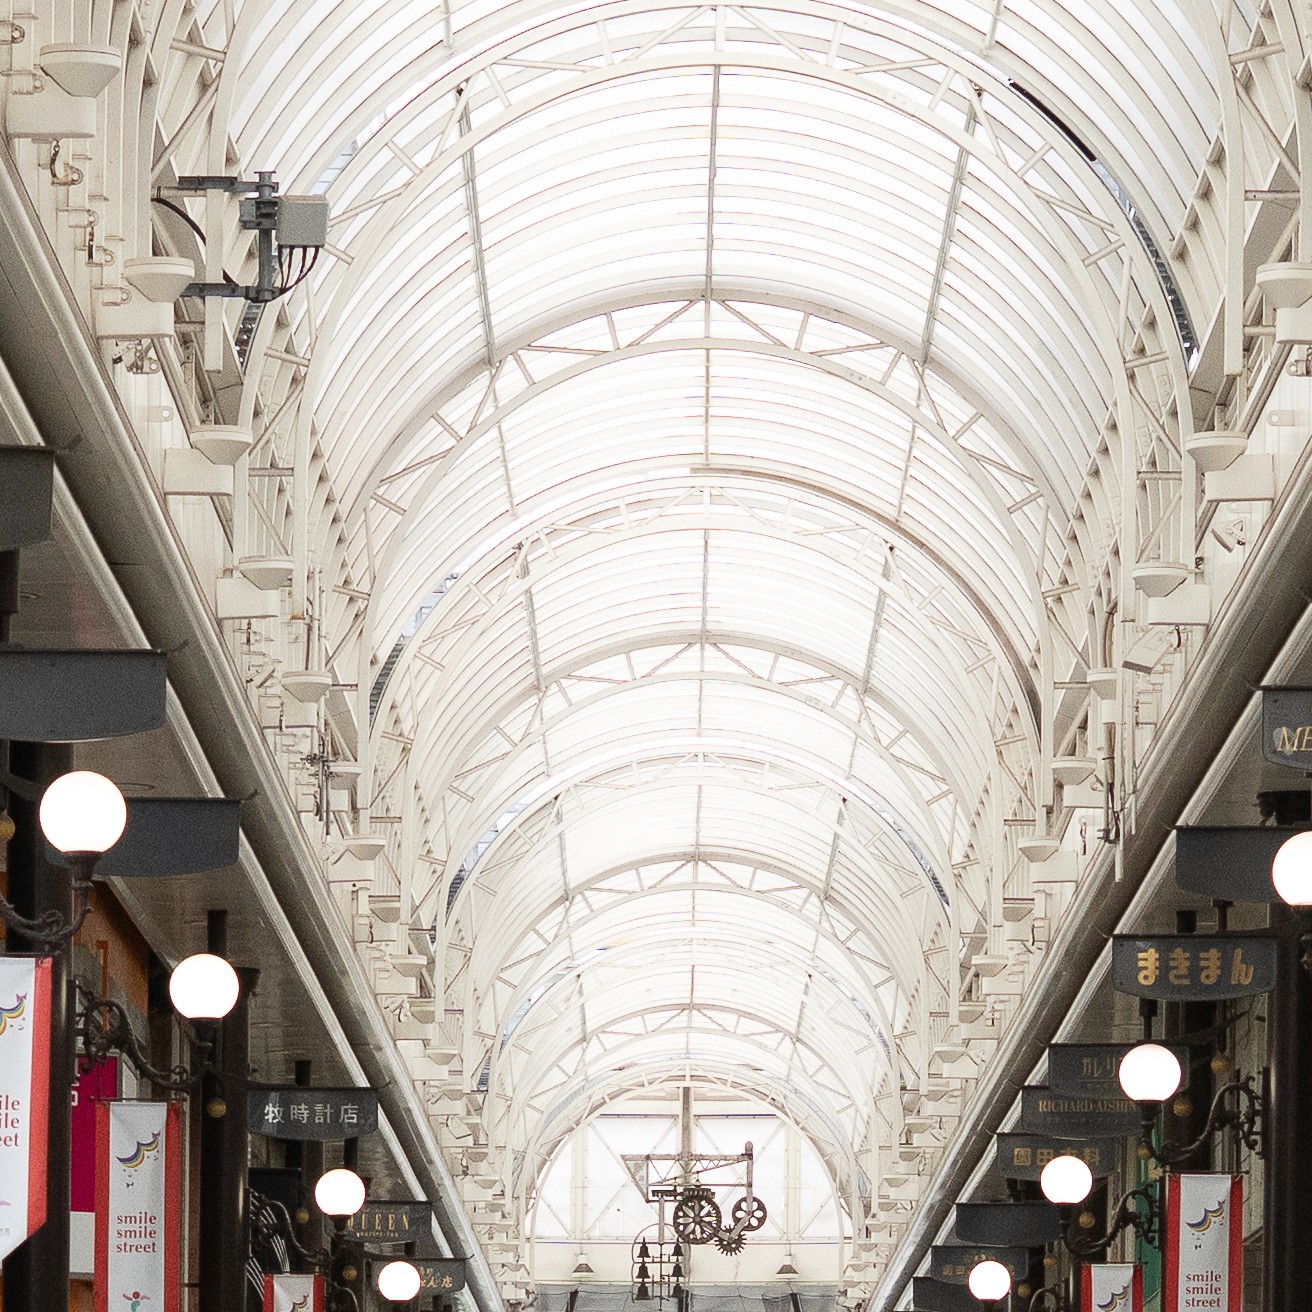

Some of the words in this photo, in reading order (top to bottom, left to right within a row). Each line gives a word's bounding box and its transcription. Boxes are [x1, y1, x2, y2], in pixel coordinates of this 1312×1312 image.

[1137, 947, 1255, 987] まきまん
[264, 1102, 360, 1125] 牧時計店
[116, 1211, 157, 1225] smile
[346, 1212, 410, 1231] QUEEN
[116, 1225, 157, 1240] smile
[116, 1241, 157, 1254] street
[1185, 1271, 1222, 1283] smile
[1185, 1283, 1222, 1296] smile
[1185, 1296, 1222, 1308] street
